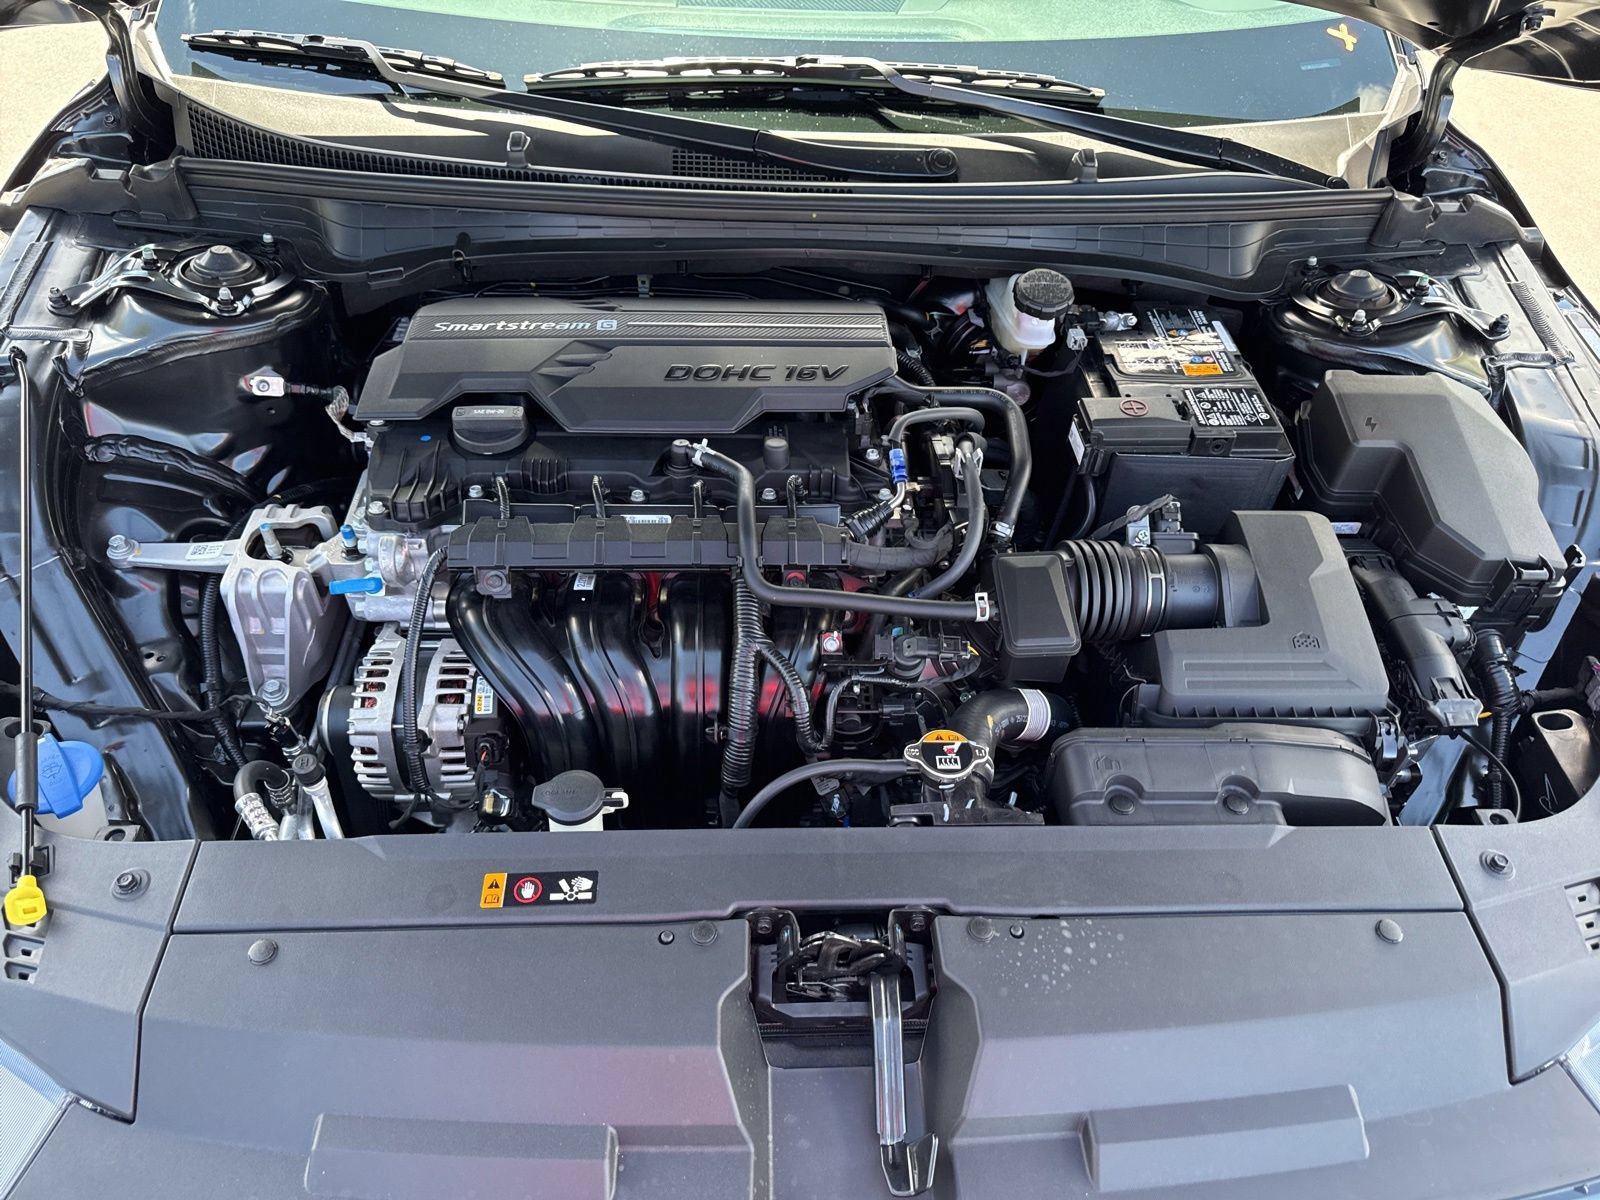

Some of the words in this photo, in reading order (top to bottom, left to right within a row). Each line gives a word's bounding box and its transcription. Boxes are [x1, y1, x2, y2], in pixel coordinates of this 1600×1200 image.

[430, 320, 591, 332] Smartstream
[599, 320, 617, 331] G
[664, 364, 777, 381] DOHC
[785, 364, 850, 381] 16V
